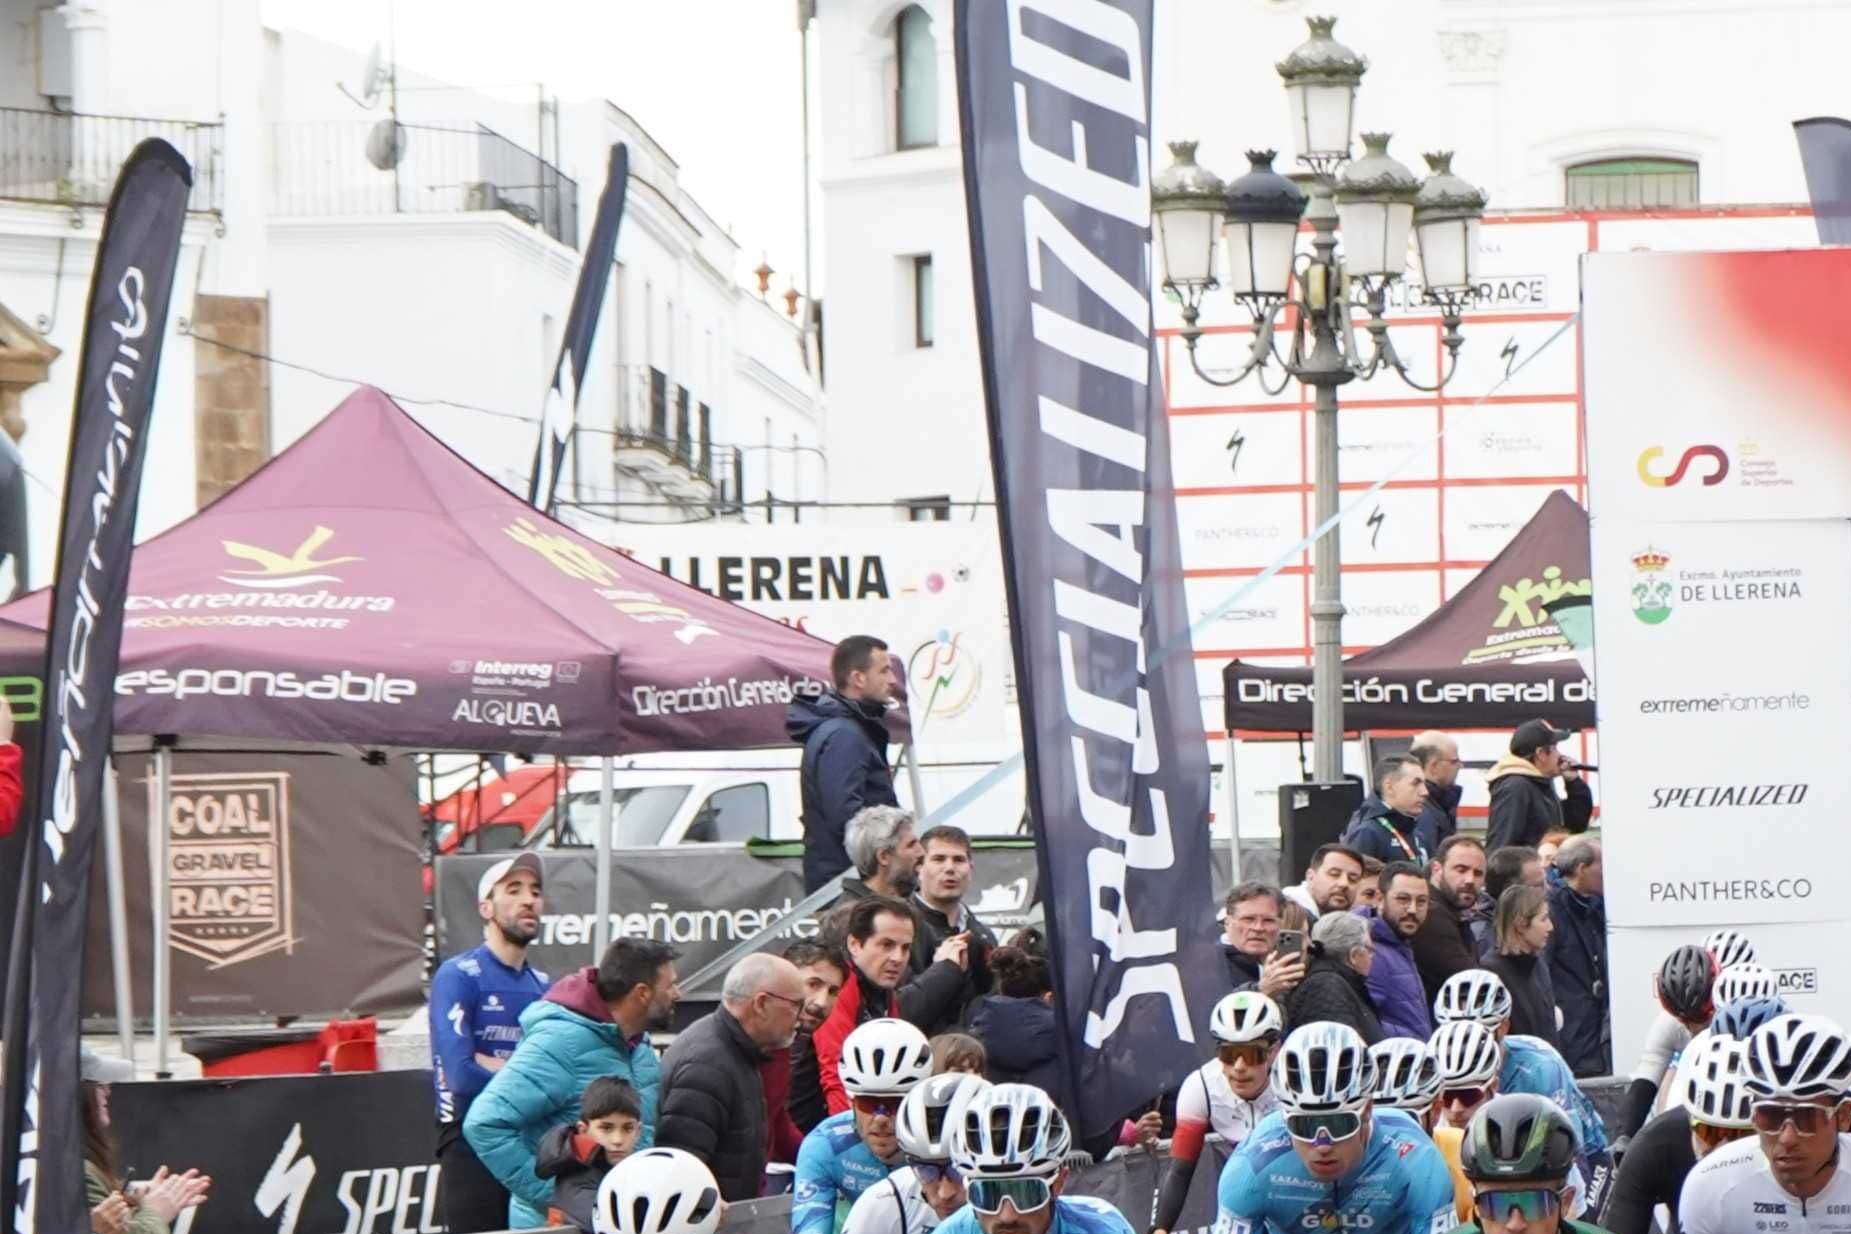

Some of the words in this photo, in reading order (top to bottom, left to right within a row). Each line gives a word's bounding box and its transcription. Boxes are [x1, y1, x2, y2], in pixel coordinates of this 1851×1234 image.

[1723, 567, 1803, 582] Ayuntamiento
[1680, 585, 1706, 603] DE
[1711, 582, 1803, 602] LLERENA
[114, 667, 416, 705] esponsable
[1416, 671, 1556, 704] General
[1648, 783, 1809, 810] SPECIALIZED
[171, 794, 272, 835] COAL
[171, 853, 271, 873] GRAVEL
[171, 886, 274, 918] RACE
[1649, 877, 1813, 902] PANTHER&CO
[1778, 971, 1815, 991] ACE
